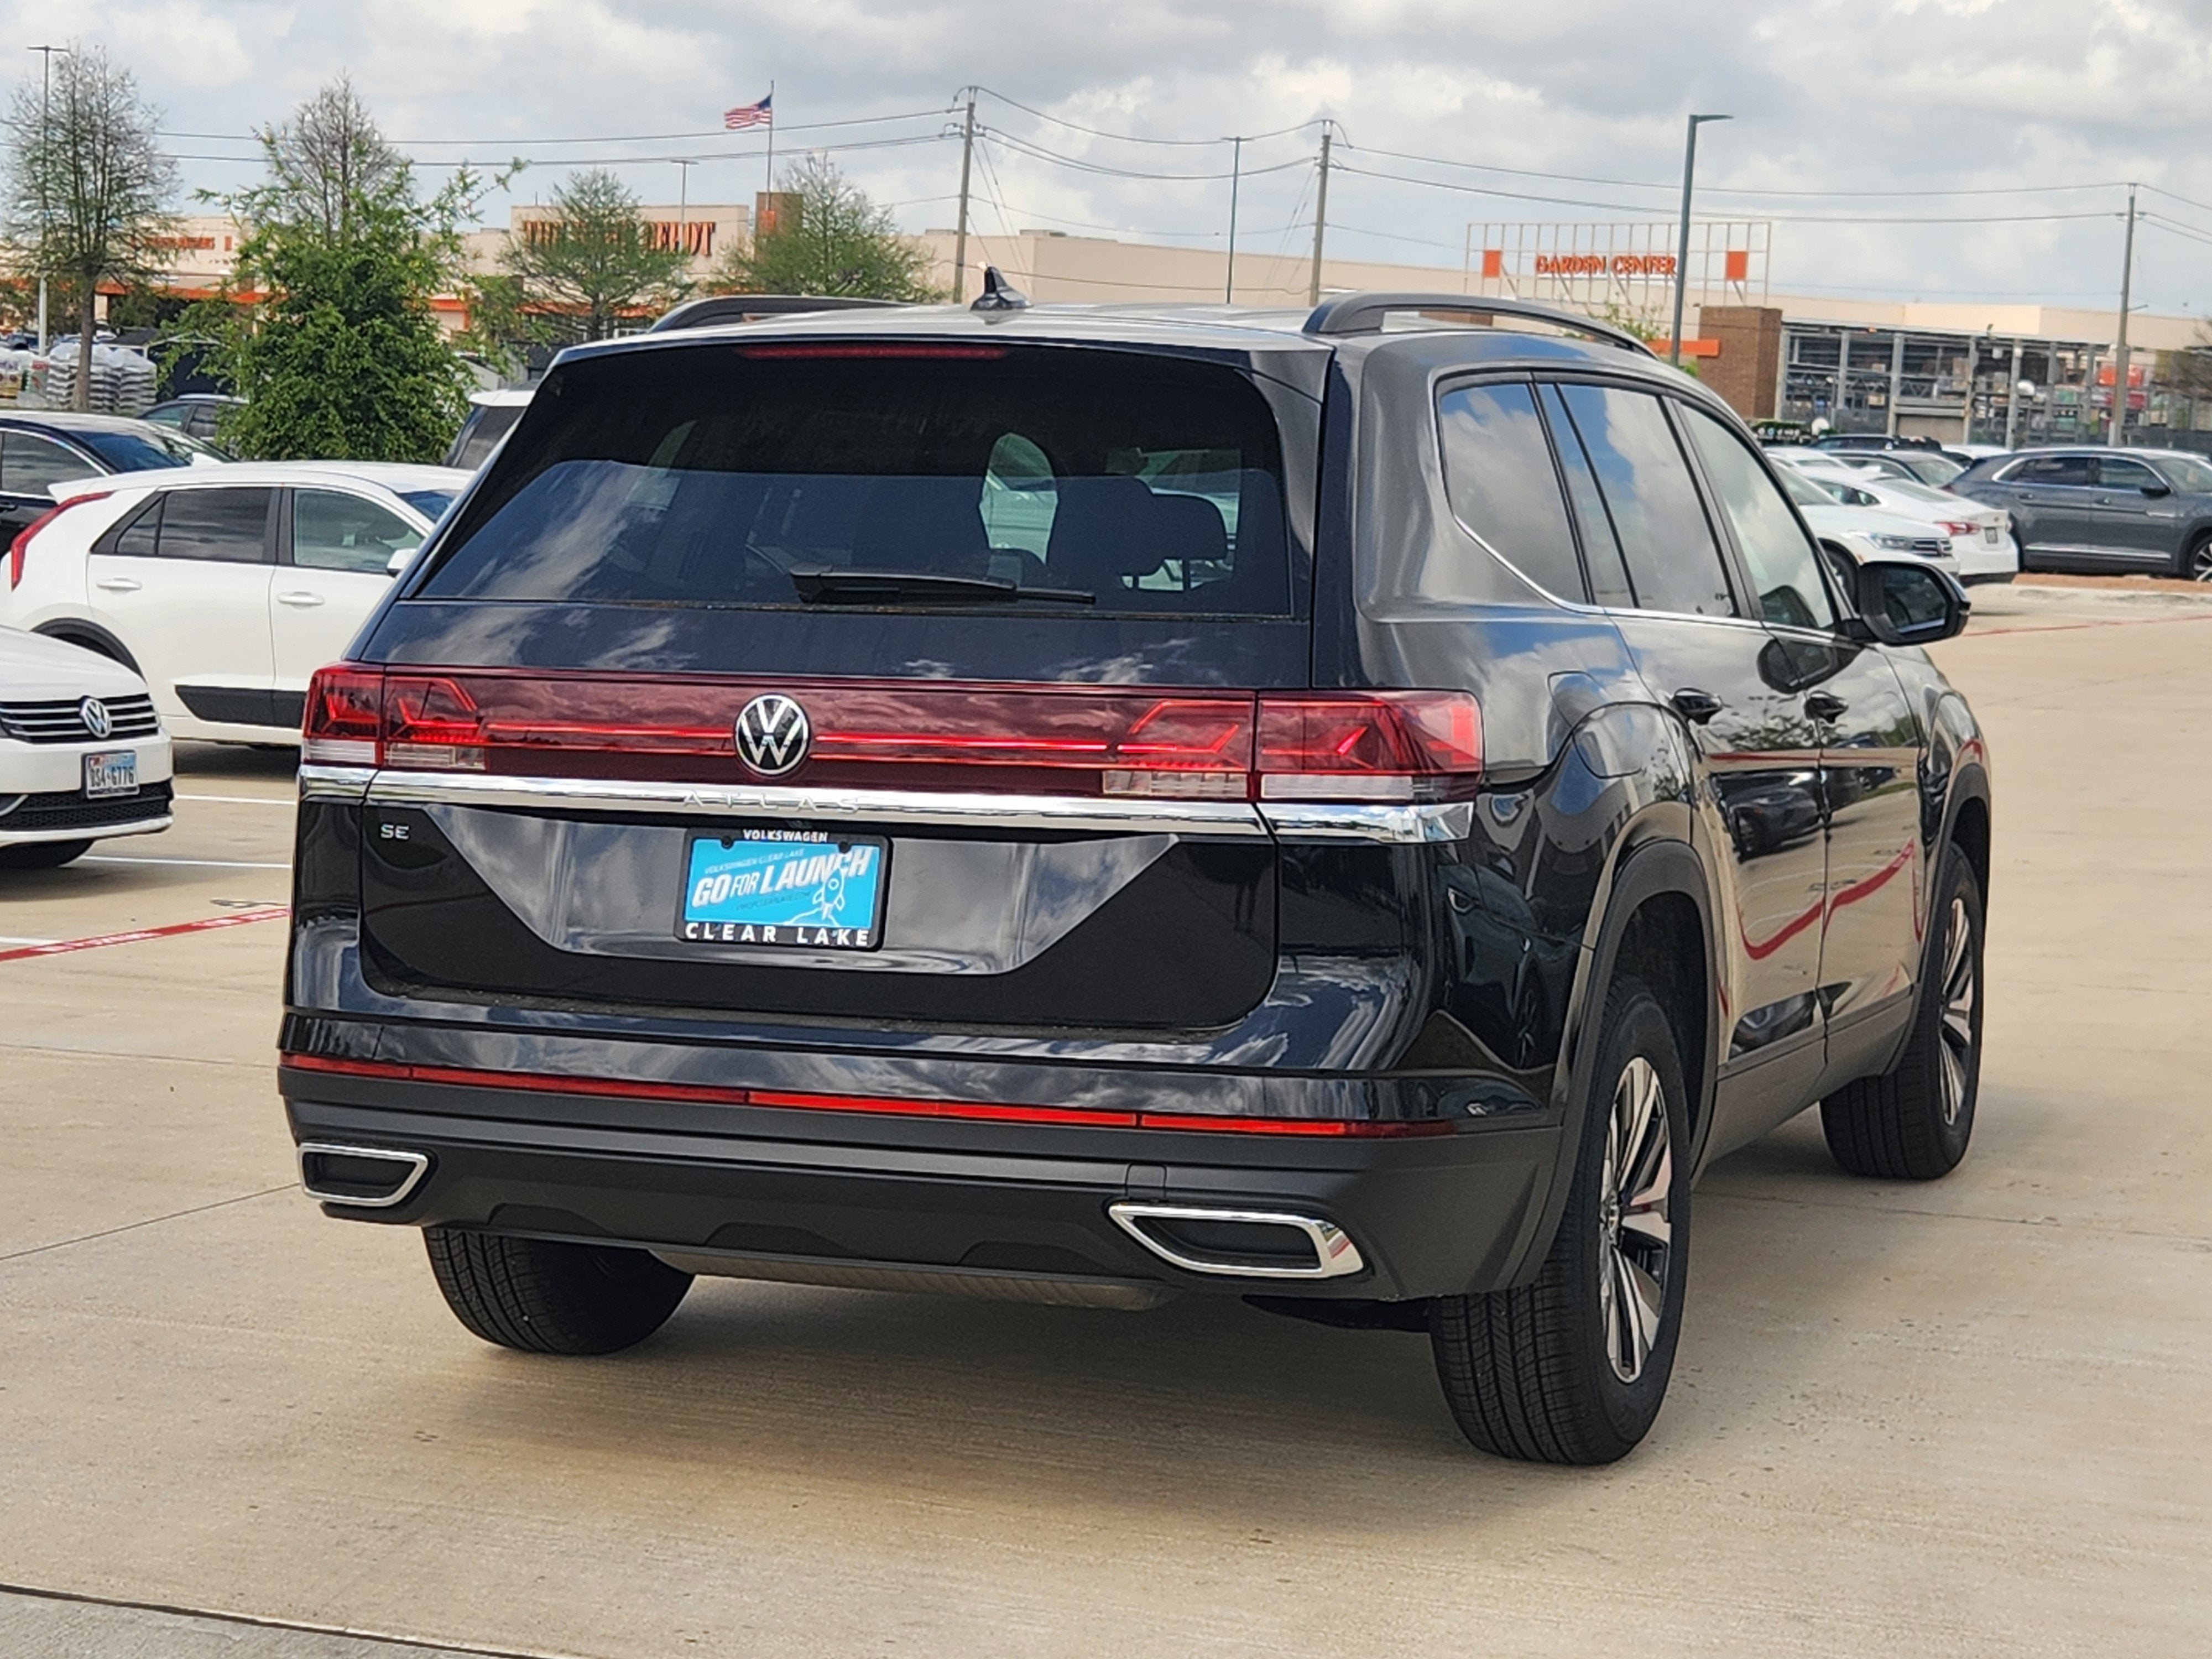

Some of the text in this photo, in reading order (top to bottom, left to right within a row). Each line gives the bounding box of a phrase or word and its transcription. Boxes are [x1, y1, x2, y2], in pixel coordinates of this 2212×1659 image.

[1536, 254, 1676, 274] GARDEN CENTER
[683, 790, 859, 814] ATLAS
[380, 823, 409, 839] SE
[743, 830, 828, 842] VOLKSWAGEN
[692, 847, 873, 907] GO FOR LAUNCH
[685, 922, 869, 946] CLEAR LAKE
